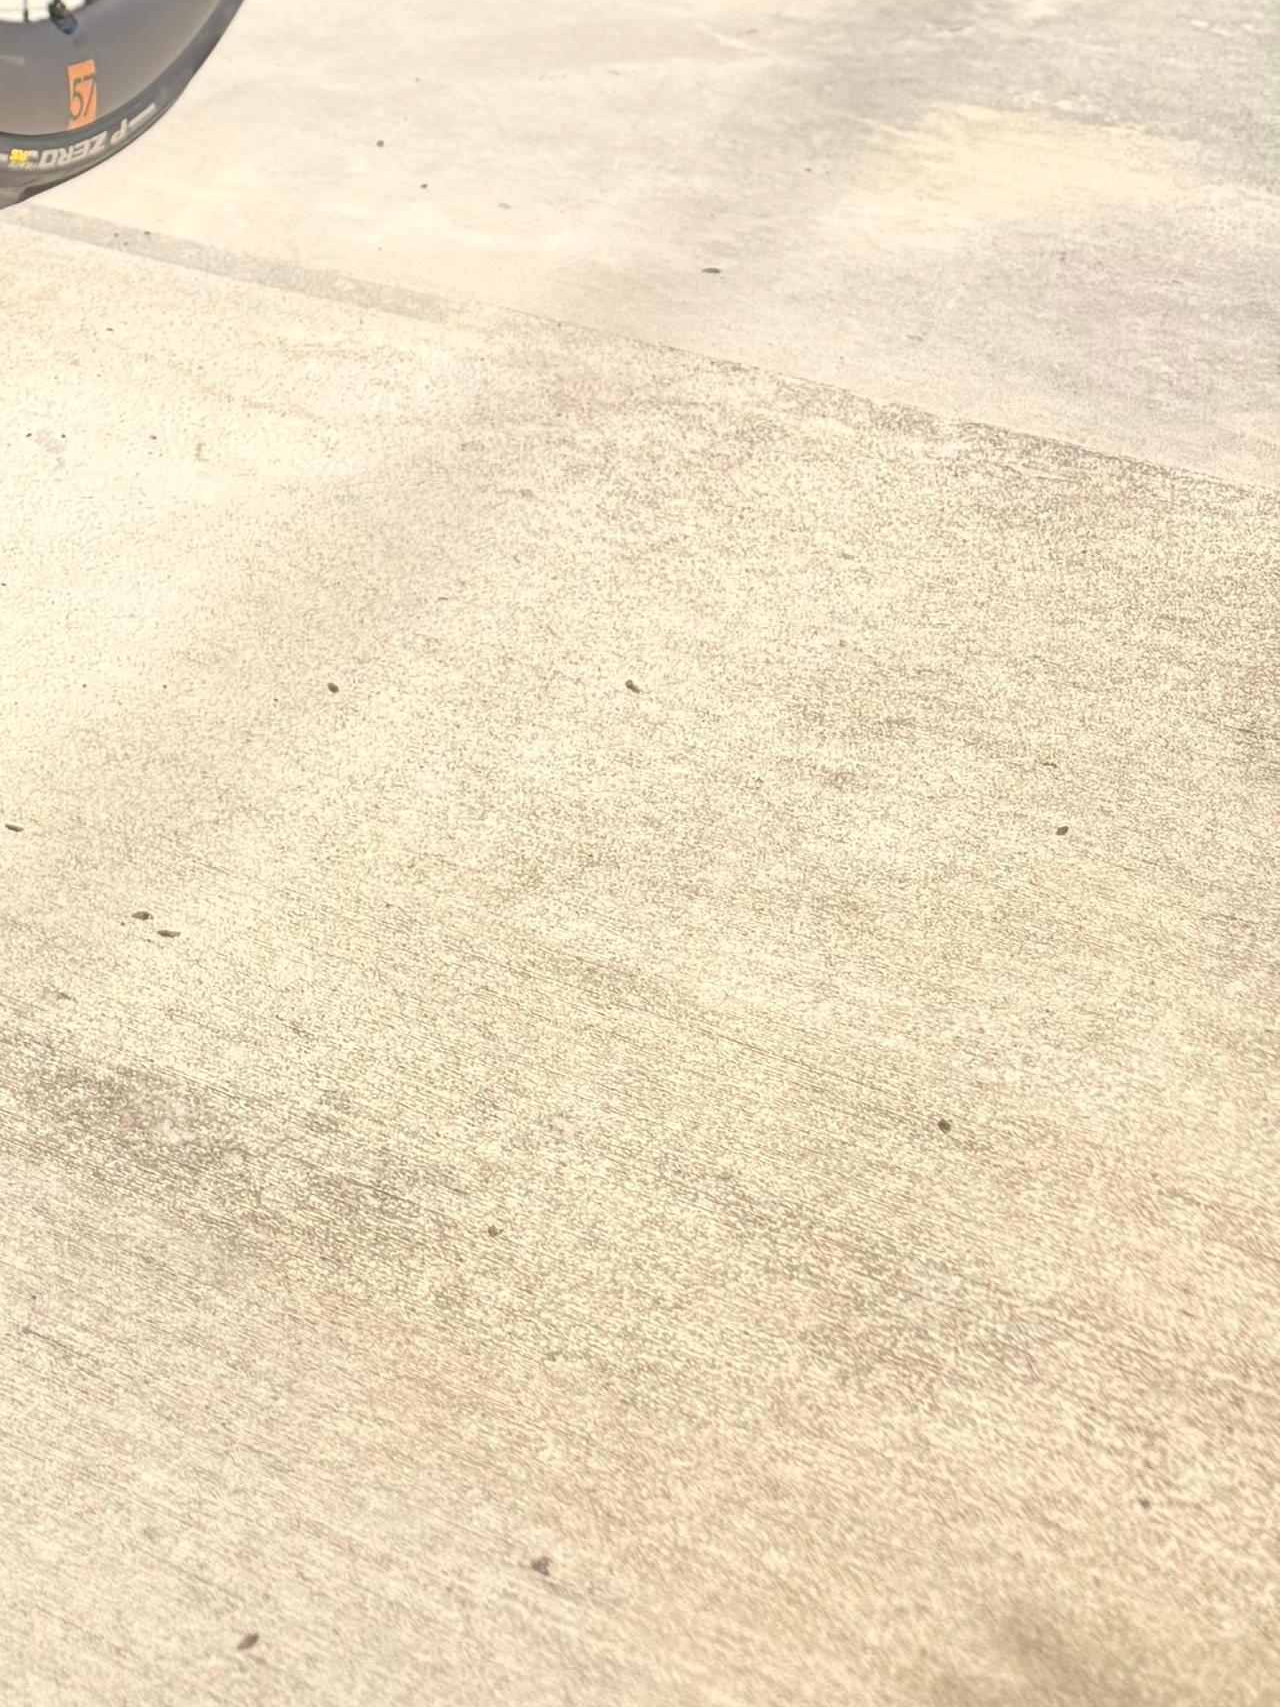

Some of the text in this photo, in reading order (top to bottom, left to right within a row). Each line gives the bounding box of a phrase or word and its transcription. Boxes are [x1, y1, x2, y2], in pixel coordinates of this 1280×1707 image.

[69, 74, 96, 120] 57
[39, 131, 108, 167] ZERO
[111, 118, 128, 147] P
